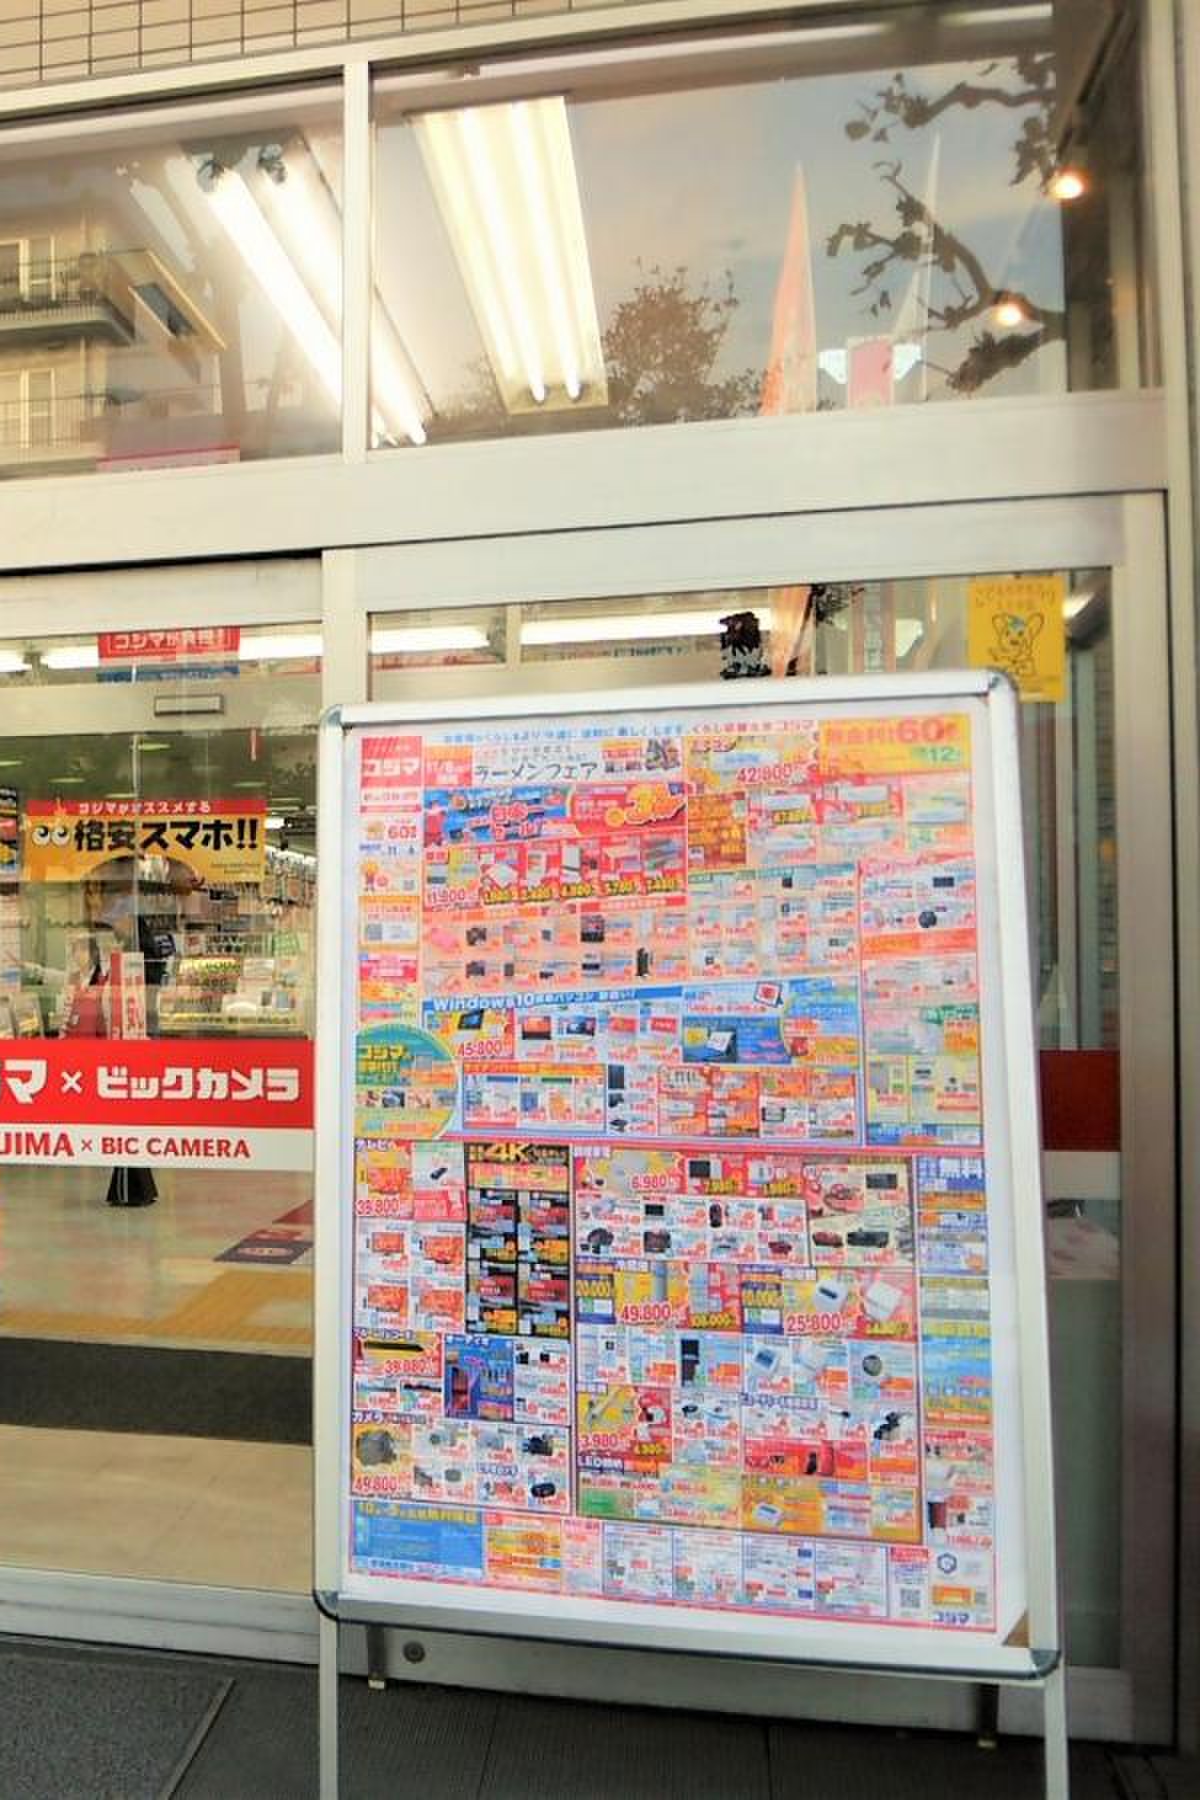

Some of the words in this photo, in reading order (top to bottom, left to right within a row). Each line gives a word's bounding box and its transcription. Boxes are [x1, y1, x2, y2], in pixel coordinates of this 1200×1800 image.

[475, 762, 598, 781] ラーメンフェア
[75, 819, 259, 850] 格安スマホ!!
[97, 1066, 300, 1101] ビックカメラ
[101, 1136, 139, 1155] BIC
[146, 1137, 251, 1159] CAMERA
